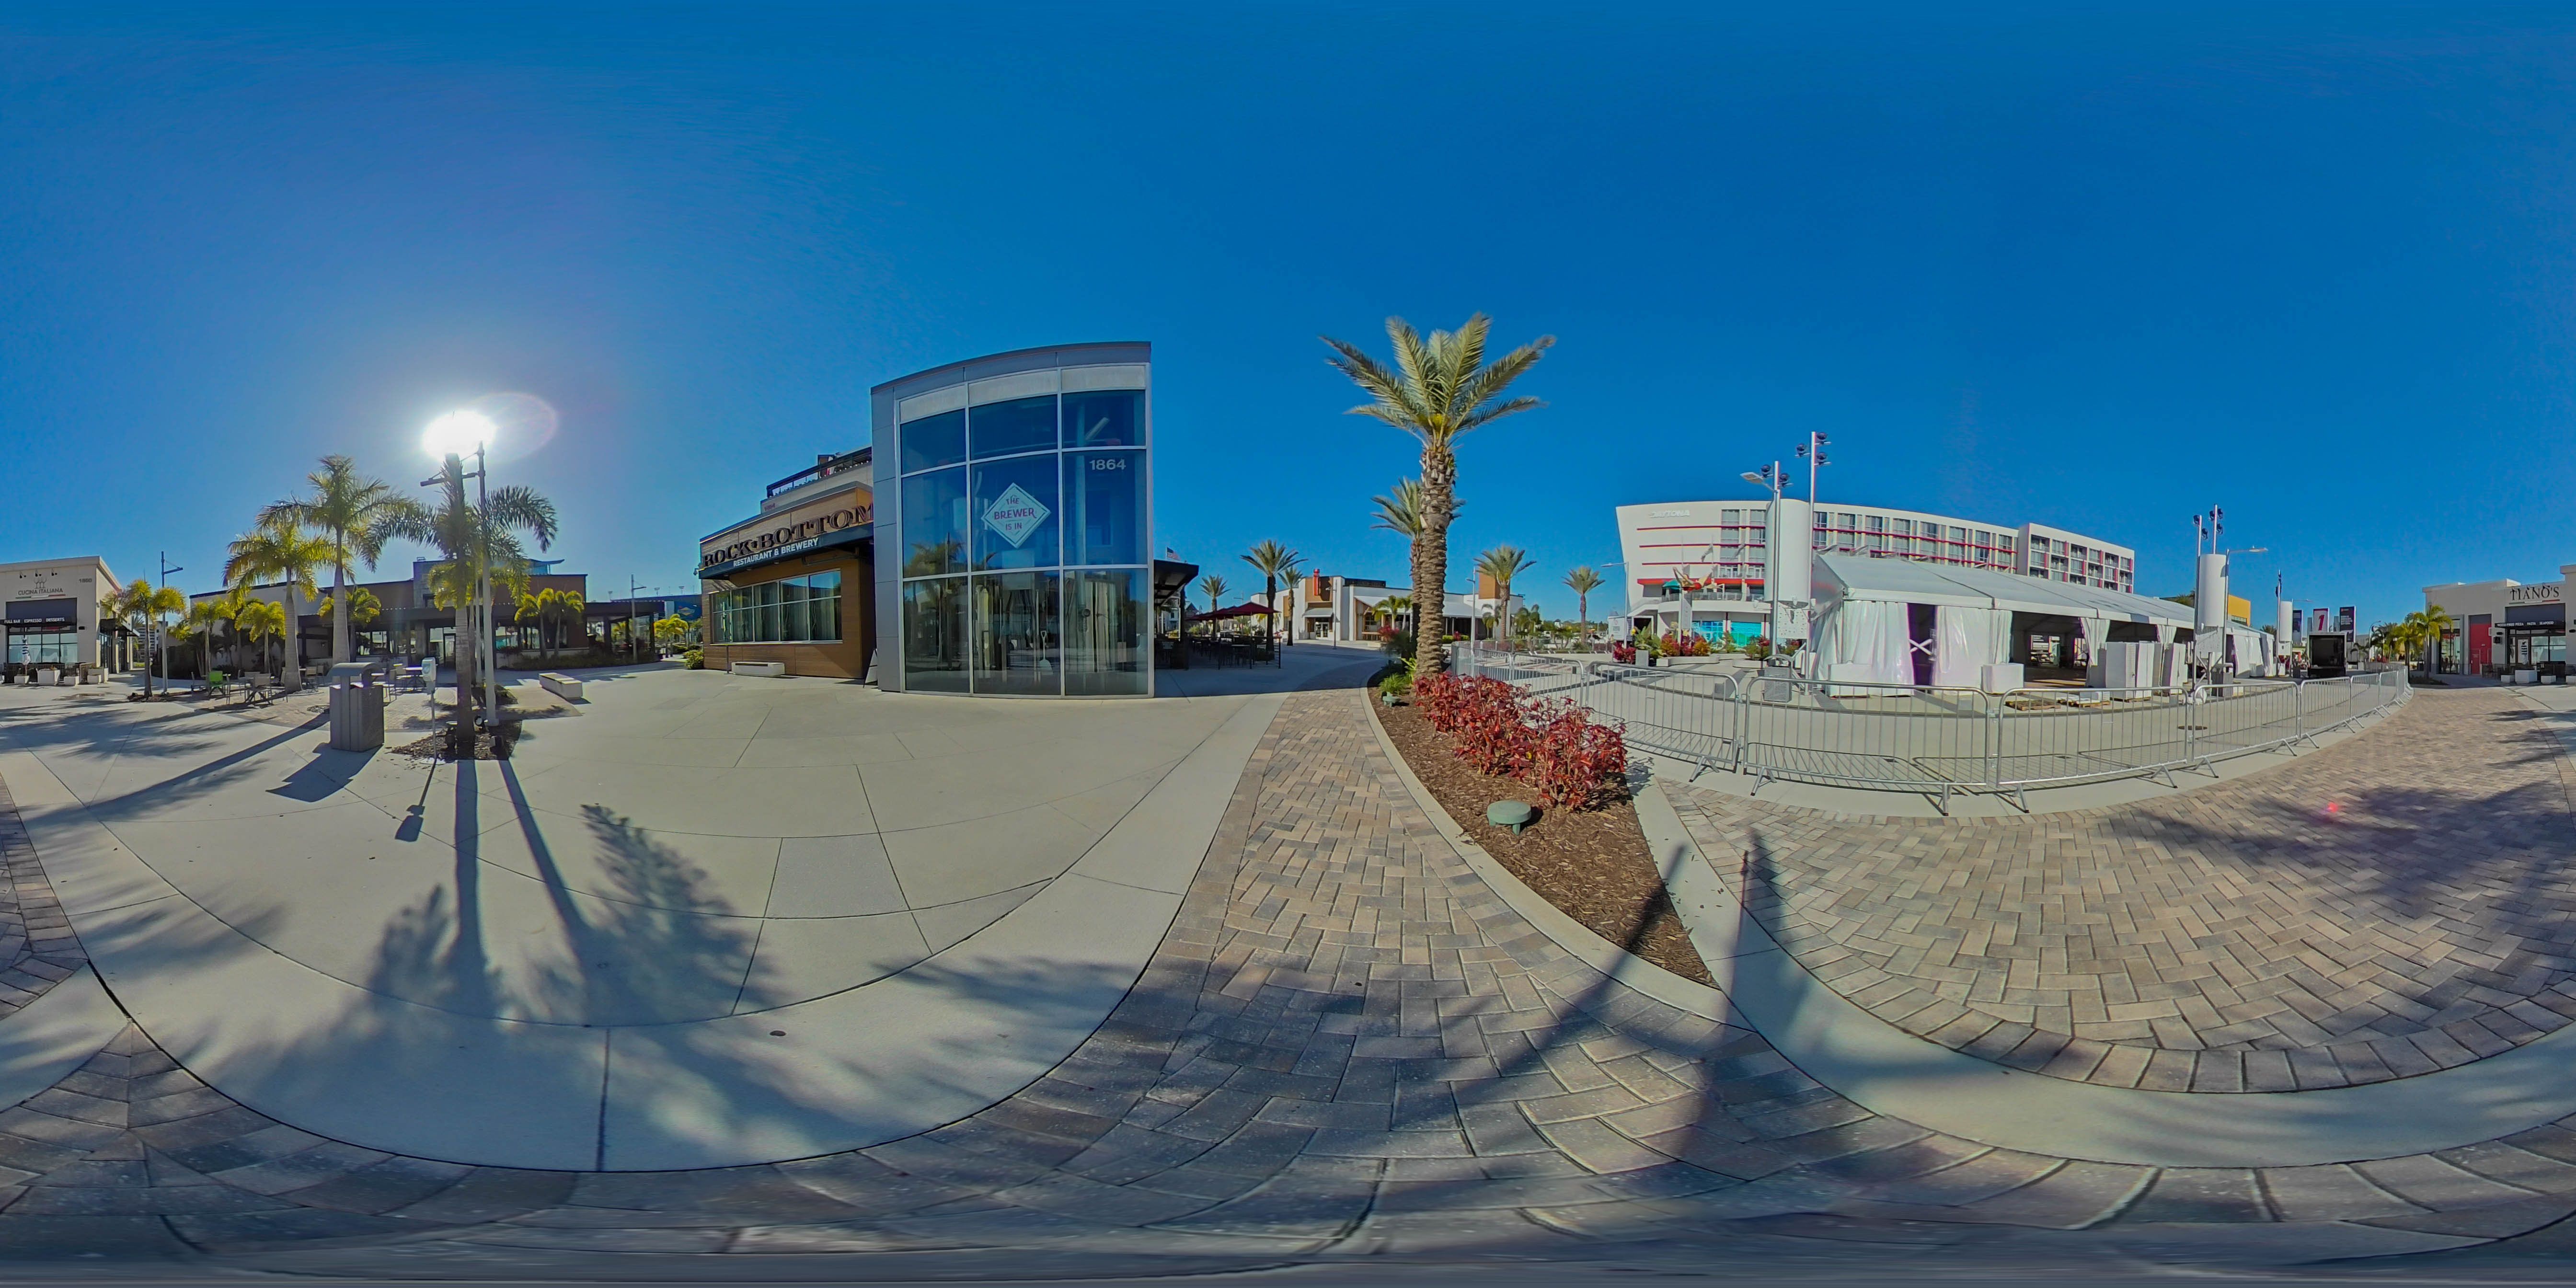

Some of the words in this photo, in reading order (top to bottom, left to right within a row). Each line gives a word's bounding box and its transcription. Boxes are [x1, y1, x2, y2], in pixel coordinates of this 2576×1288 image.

[1089, 459, 1126, 471] 1864
[1006, 496, 1020, 505] THE
[994, 508, 1037, 520] BREWER
[734, 550, 772, 567] RESTAURANT
[781, 538, 819, 554] BREWERY
[2510, 586, 2559, 600] TIANO'S
